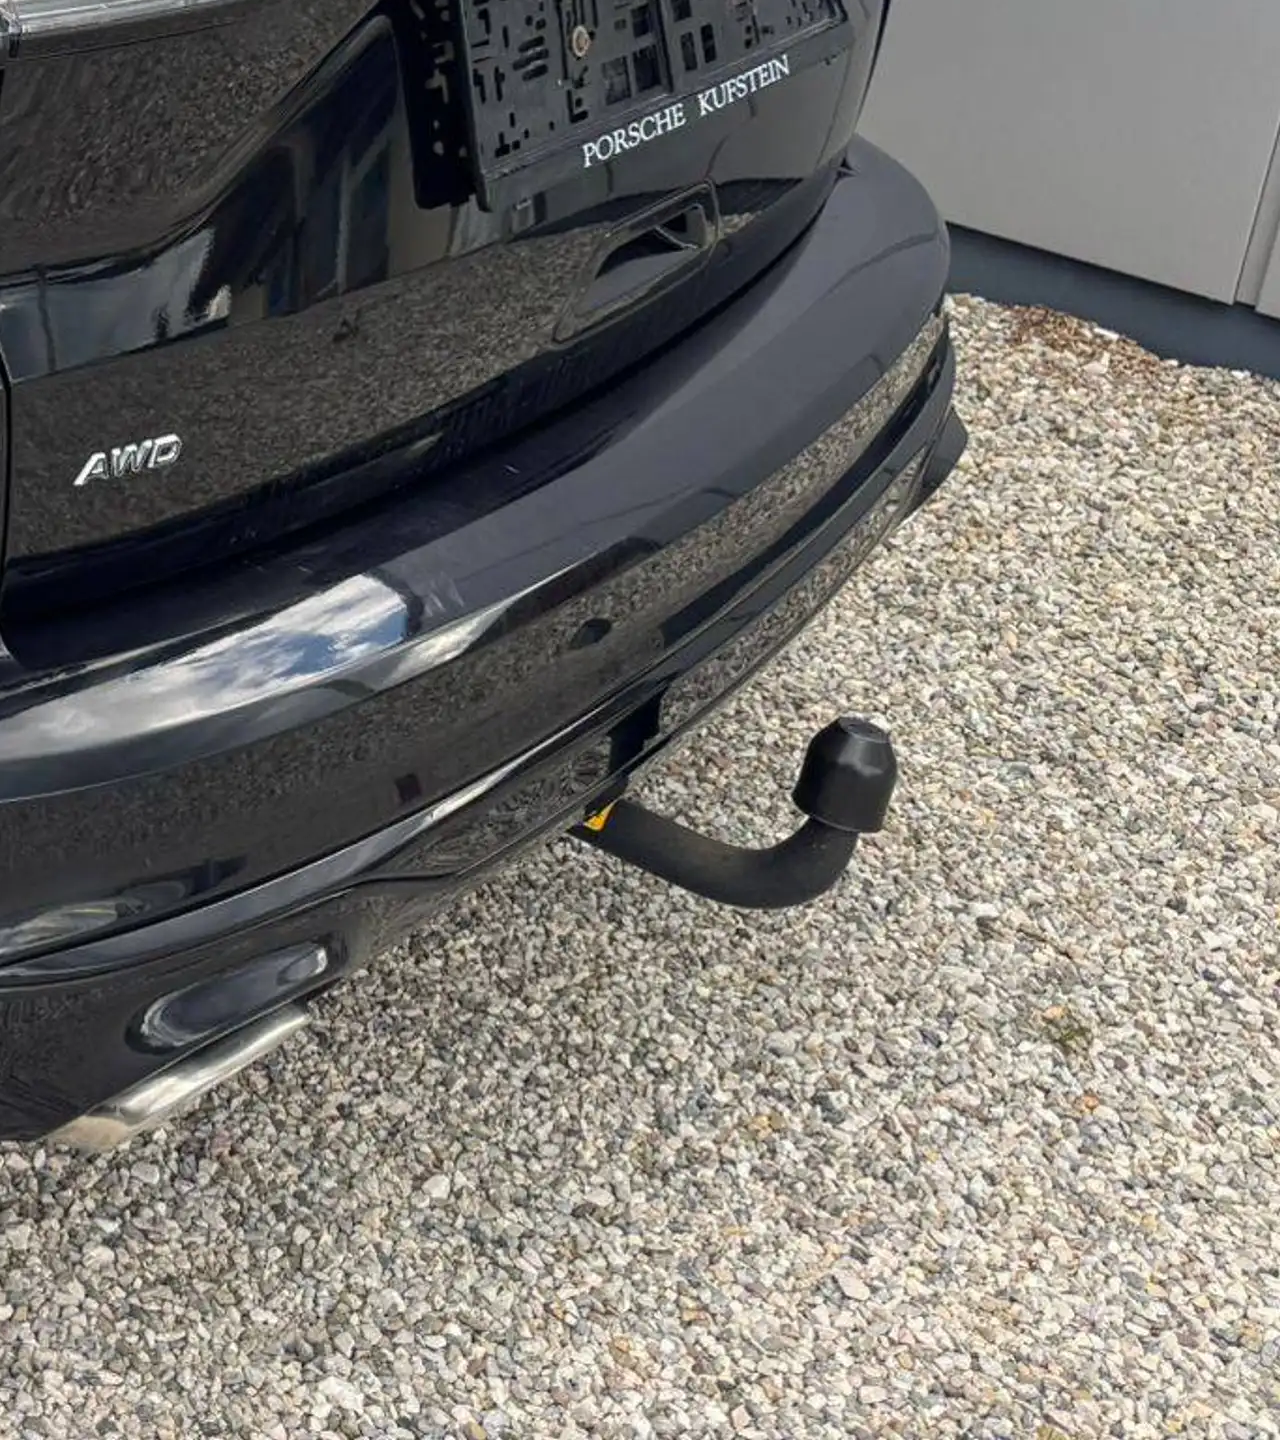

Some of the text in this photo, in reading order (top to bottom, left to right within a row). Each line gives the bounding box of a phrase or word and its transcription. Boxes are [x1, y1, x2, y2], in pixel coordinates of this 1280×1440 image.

[581, 54, 791, 169] PORSCHE KUFSTEIN
[72, 433, 184, 487] AWD
